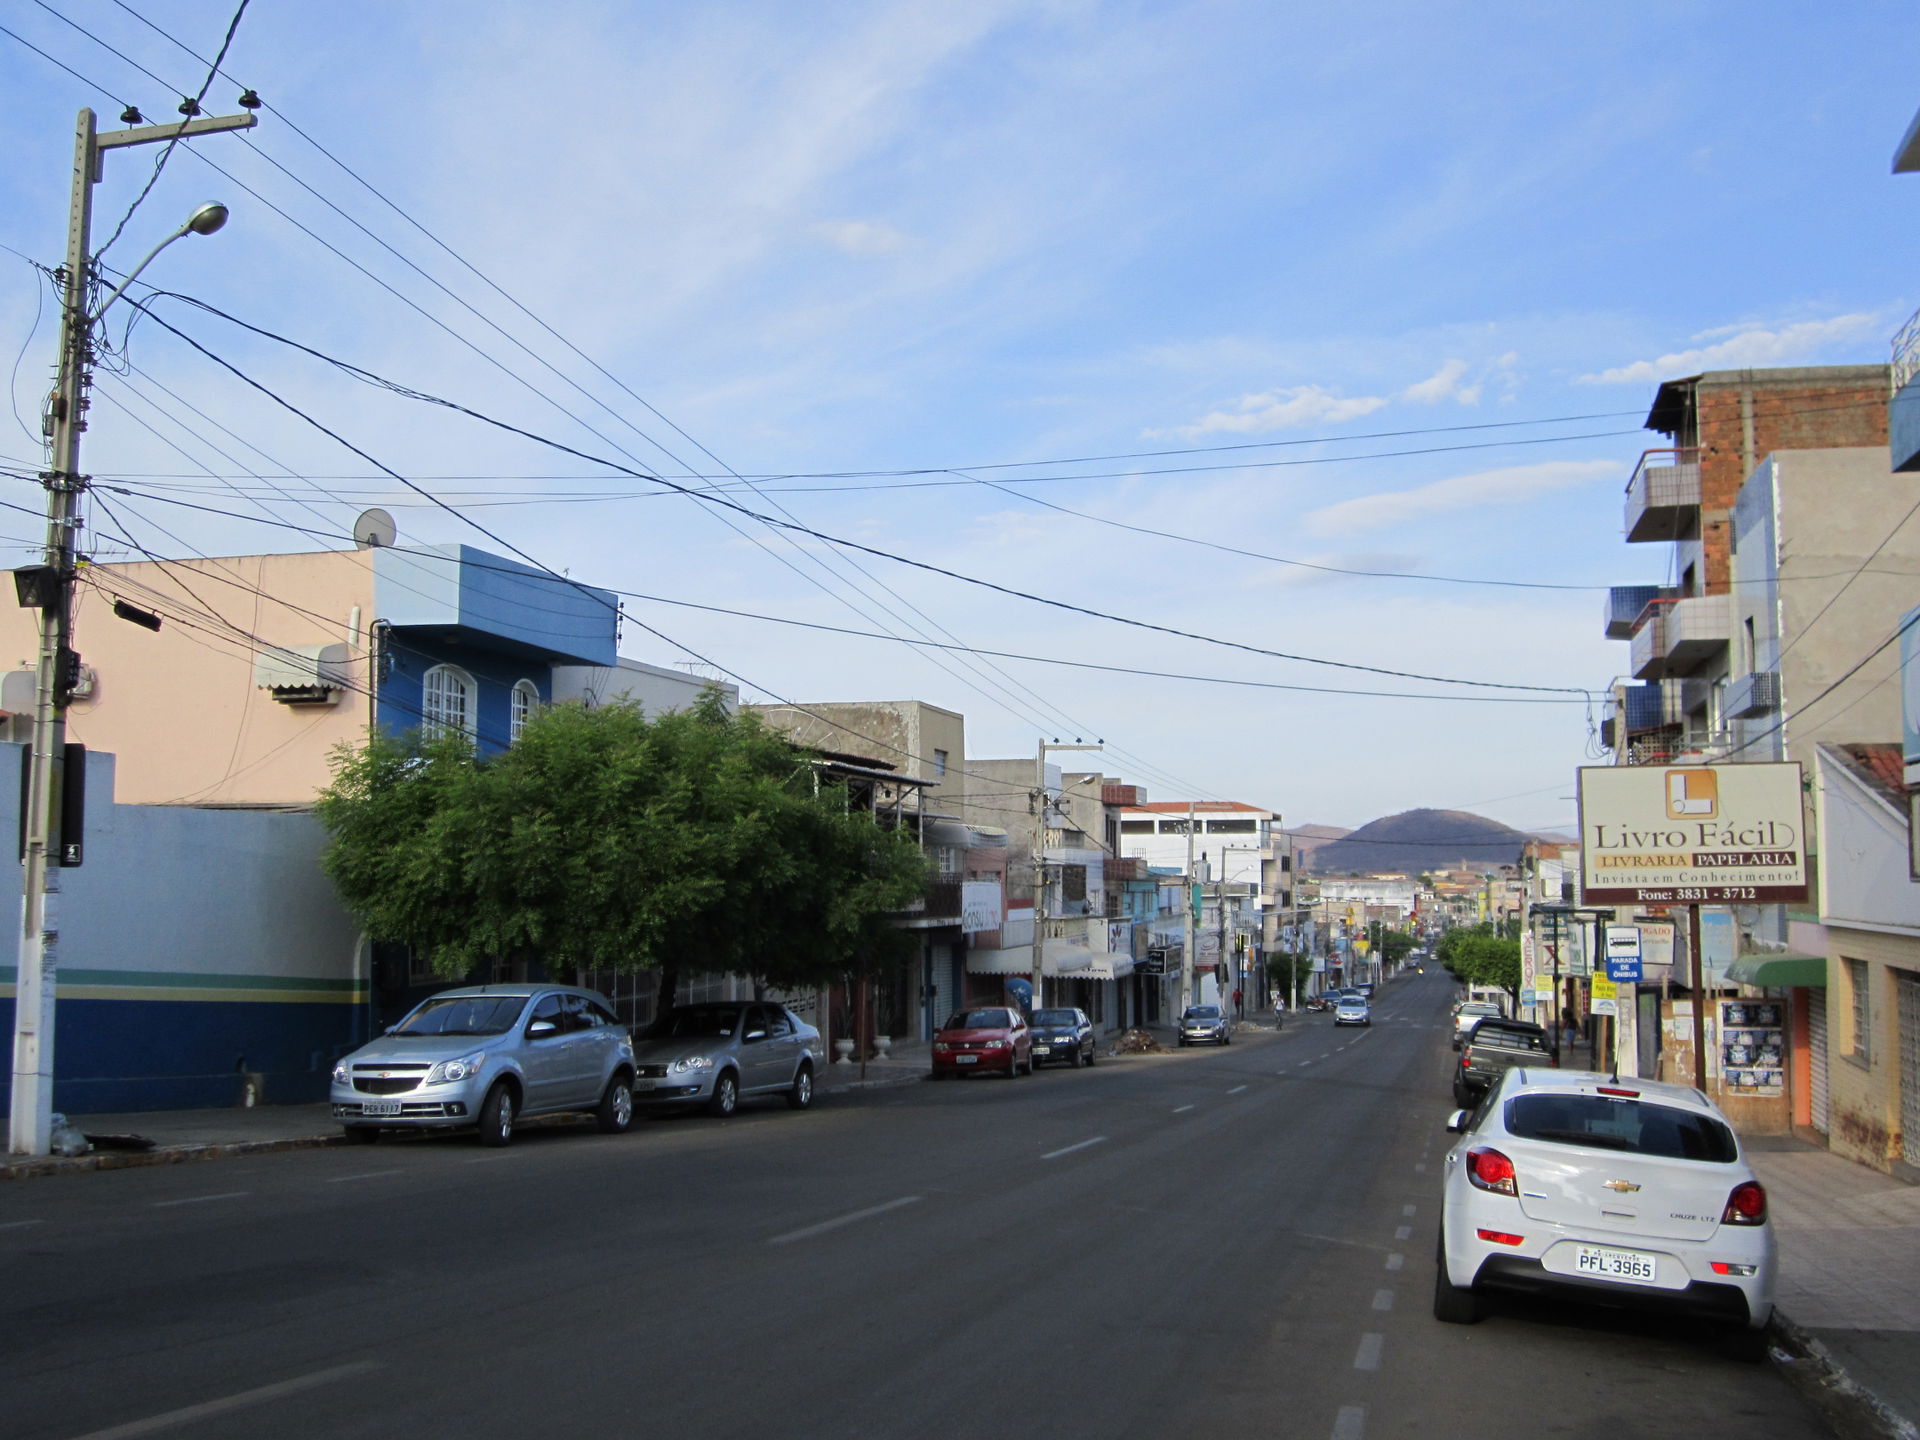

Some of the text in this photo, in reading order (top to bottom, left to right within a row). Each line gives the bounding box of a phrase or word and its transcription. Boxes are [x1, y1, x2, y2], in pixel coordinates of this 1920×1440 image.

[1594, 820, 1782, 849] Livro Fácil
[1601, 852, 1794, 868] LIVRARIA PAPELARIA
[1594, 870, 1800, 884] Invista em Conhecimento!
[1637, 889, 1673, 901] Fone:
[1676, 888, 1710, 900] 3831
[1722, 887, 1756, 899] 3712
[1524, 935, 1534, 988] XEROX
[1670, 1213, 1697, 1221] CRUZE
